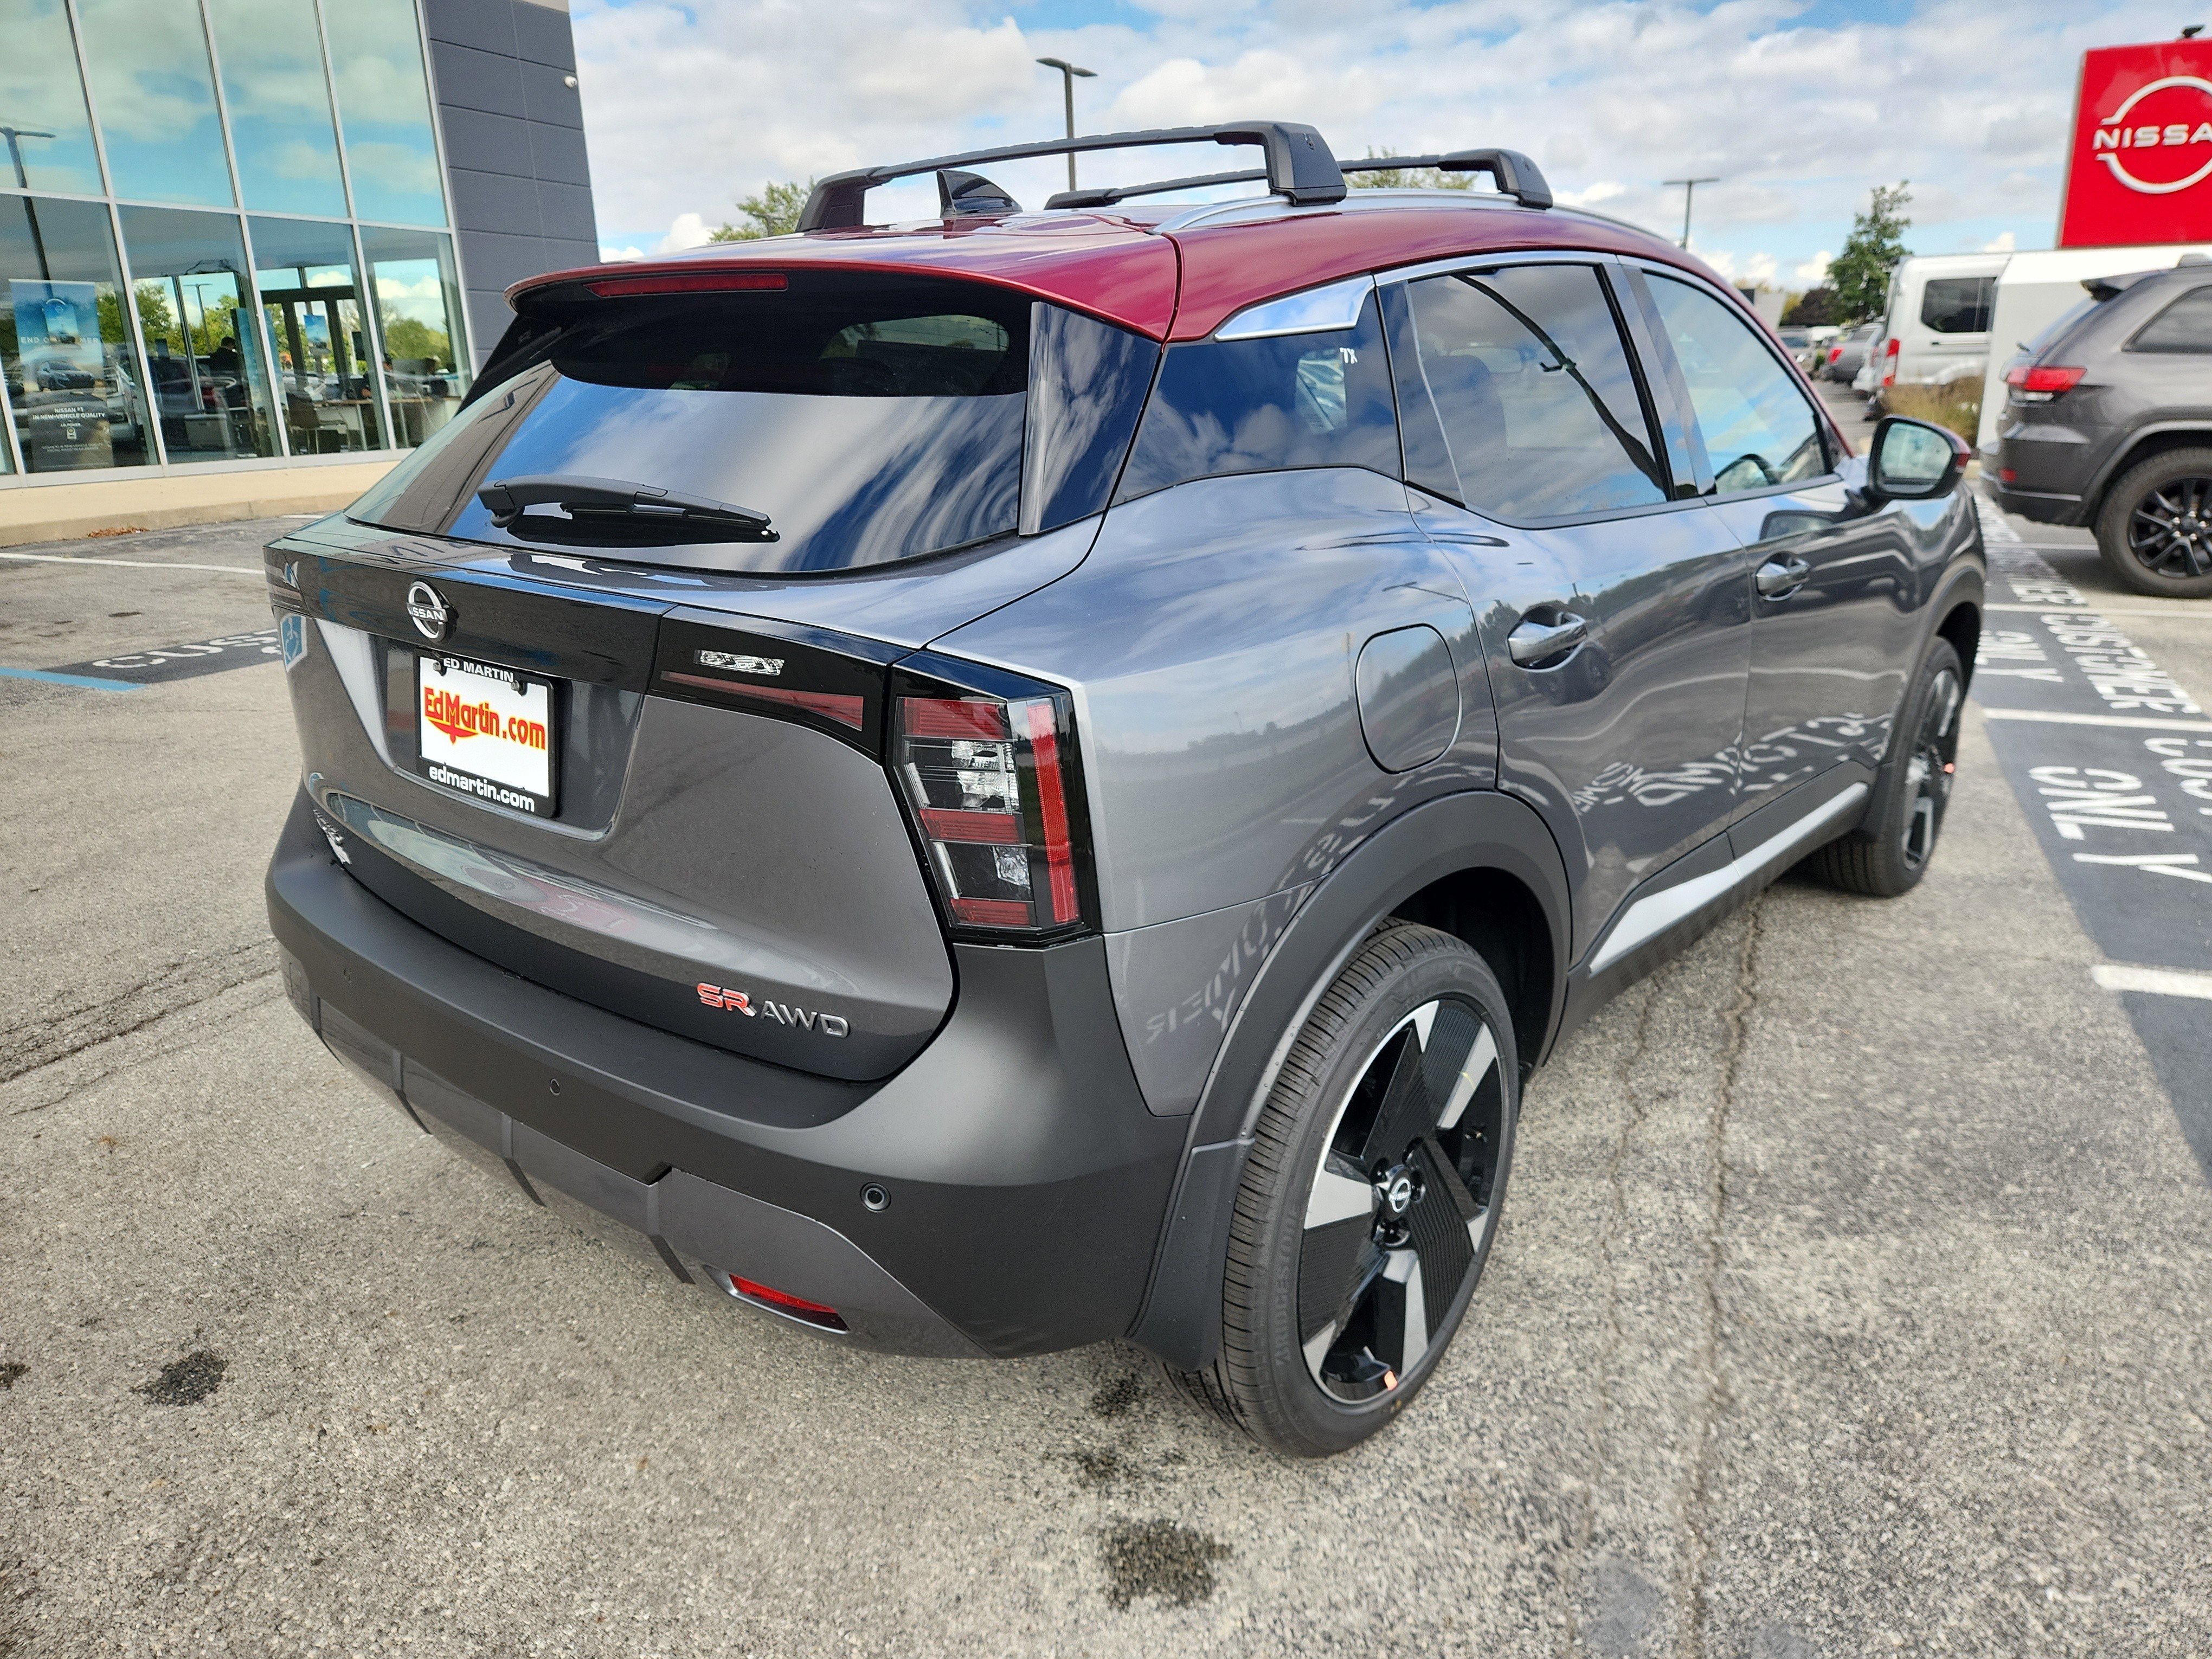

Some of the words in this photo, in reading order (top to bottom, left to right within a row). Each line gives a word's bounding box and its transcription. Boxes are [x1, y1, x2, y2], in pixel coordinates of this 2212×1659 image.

[2093, 122, 2212, 150] NISSA
[408, 603, 445, 621] SSAN
[443, 657, 460, 670] ED
[463, 661, 514, 683] MARTIN
[423, 686, 546, 750] EdMartin.com
[429, 766, 535, 812] edmartin.com
[2029, 766, 2212, 883] ONLY
[696, 982, 757, 1017] SR
[761, 1000, 851, 1038] AWD
